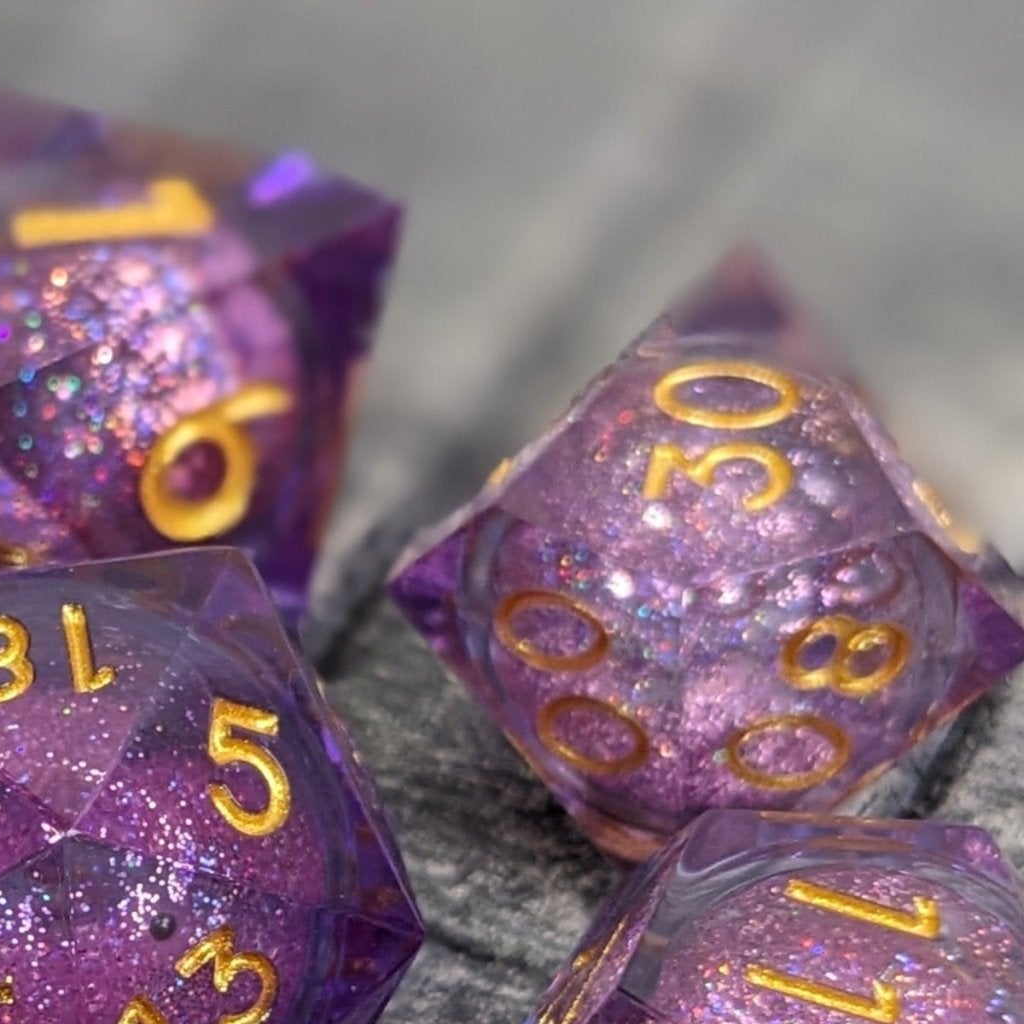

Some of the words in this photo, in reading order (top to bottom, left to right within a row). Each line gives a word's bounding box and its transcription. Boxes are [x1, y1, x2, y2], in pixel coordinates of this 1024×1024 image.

[11, 177, 214, 247] 1
[208, 697, 292, 837] 5
[743, 878, 941, 1024] 11
